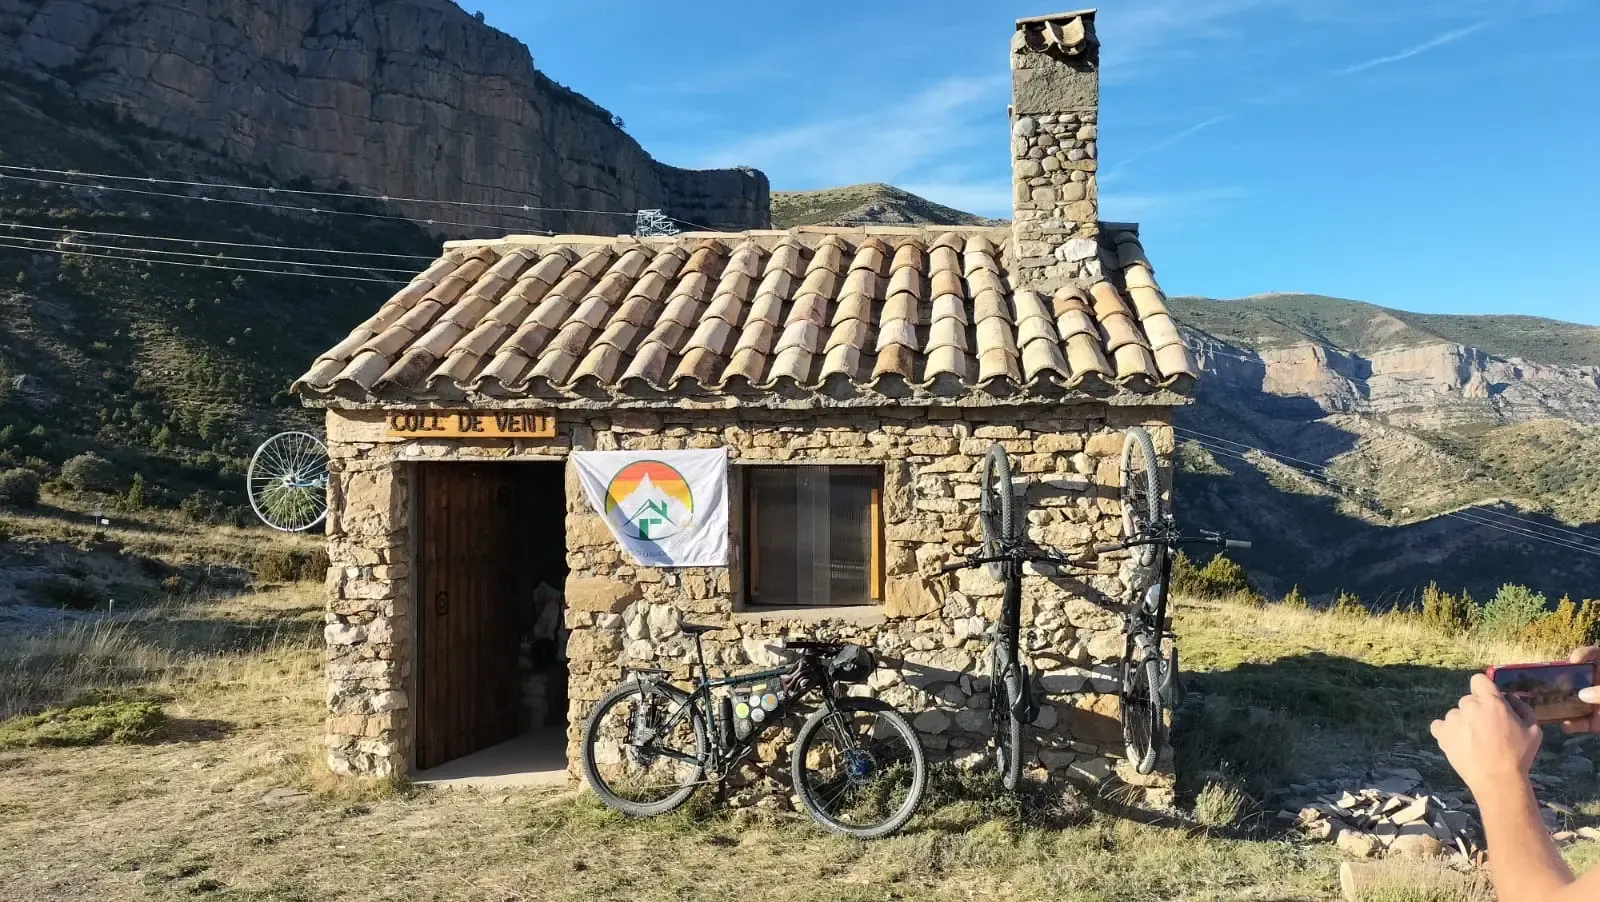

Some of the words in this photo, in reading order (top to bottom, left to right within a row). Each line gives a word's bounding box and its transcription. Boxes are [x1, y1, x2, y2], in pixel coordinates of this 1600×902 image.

[391, 411, 445, 431] COLL
[457, 411, 484, 432] DE
[495, 411, 549, 432] VENT
